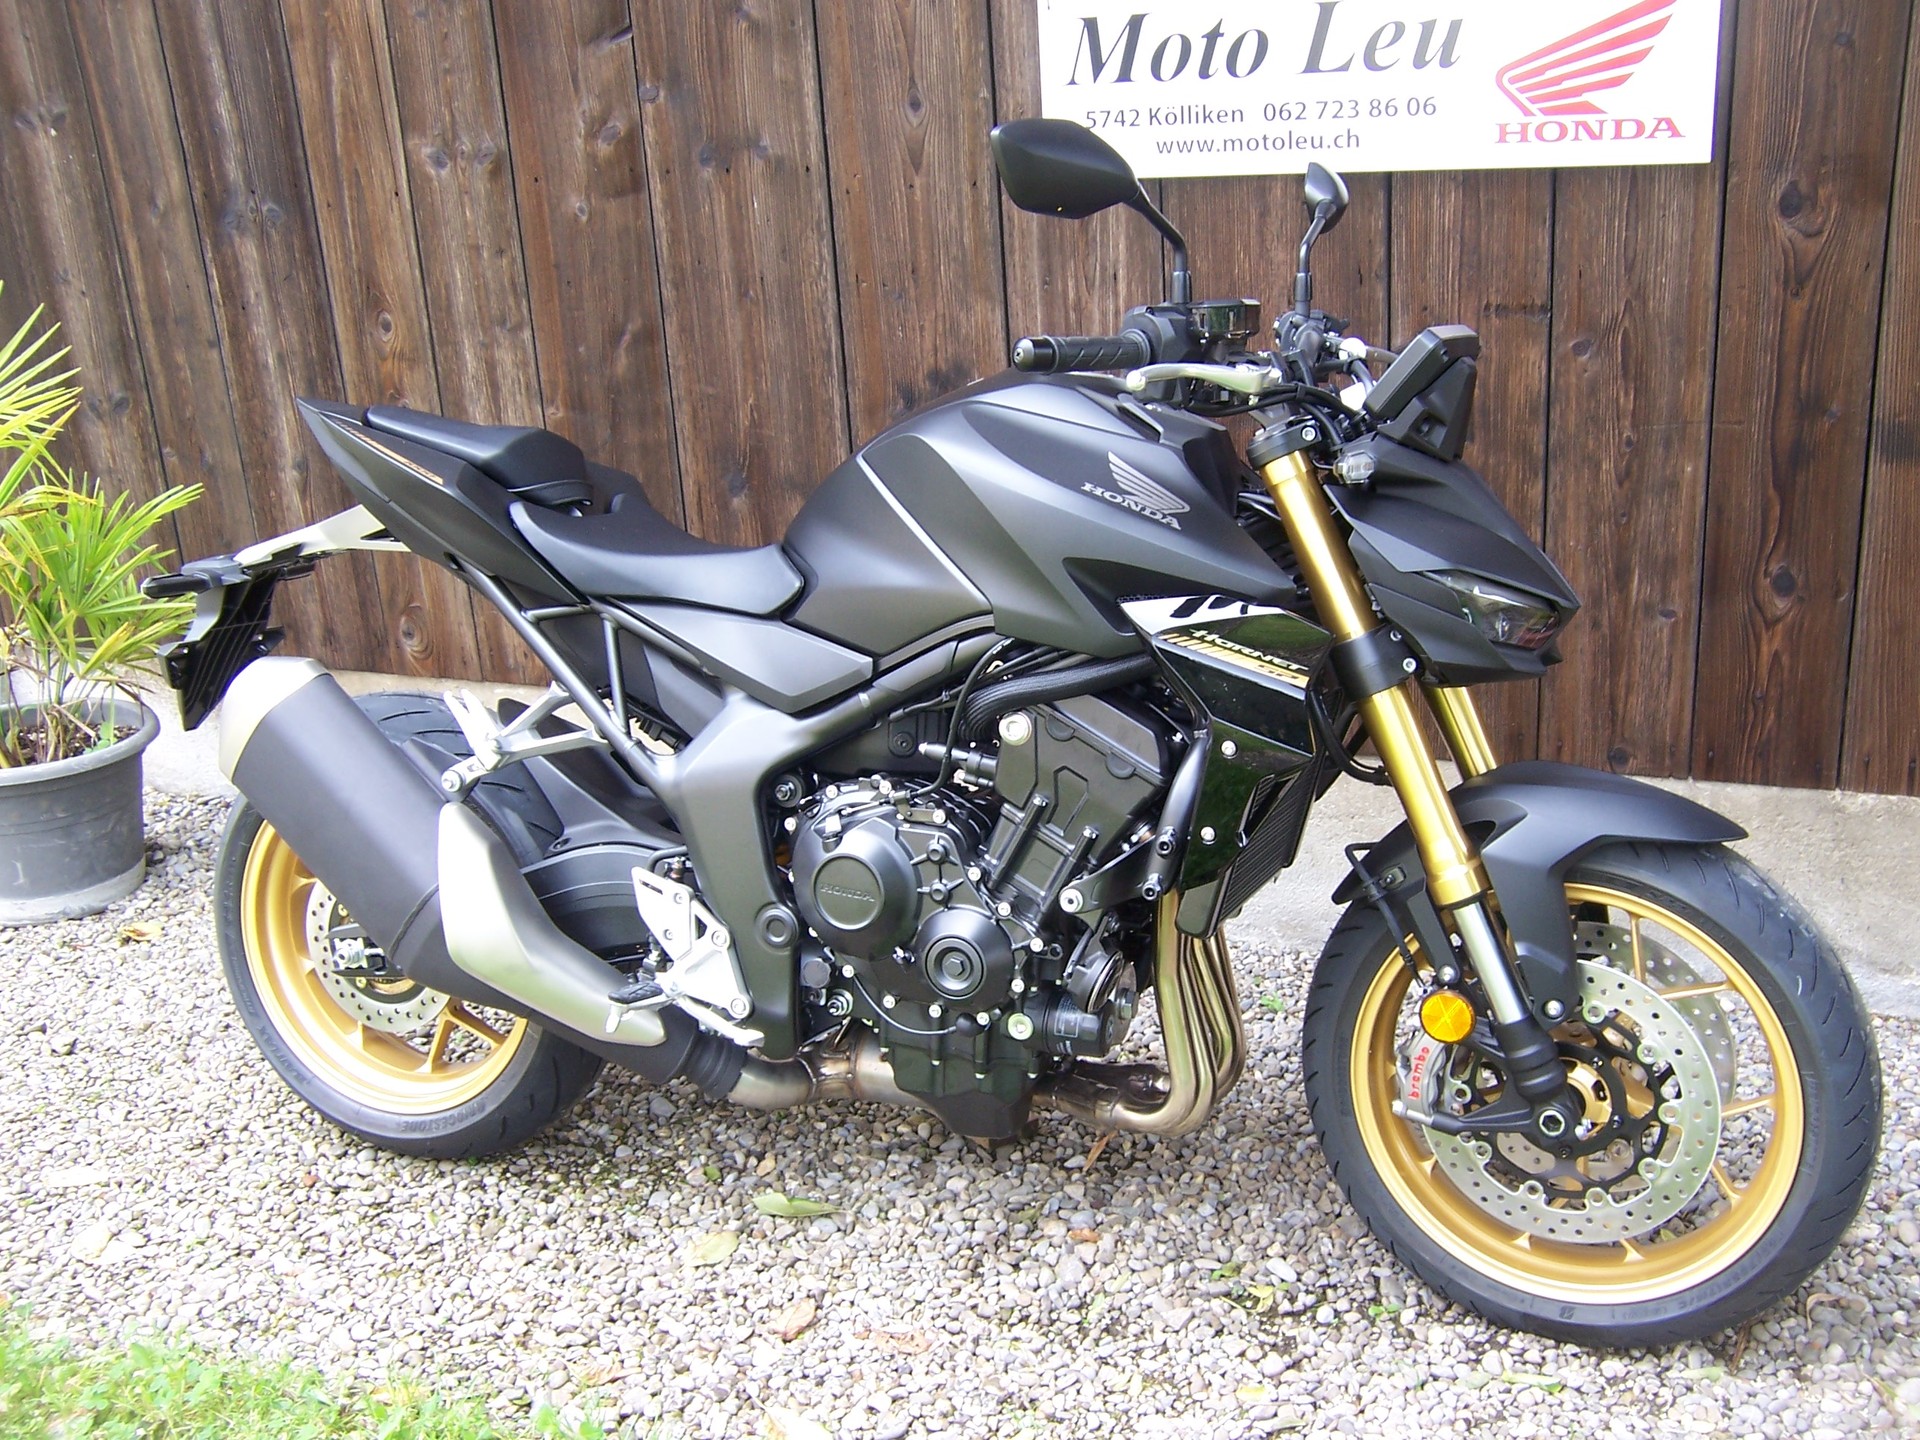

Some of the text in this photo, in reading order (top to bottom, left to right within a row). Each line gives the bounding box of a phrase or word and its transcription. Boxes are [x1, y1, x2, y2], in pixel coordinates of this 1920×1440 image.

[1064, 1, 1463, 86] Moto Leu
[1085, 96, 1437, 130] 5742 Kölliken 062 723 86 06
[1156, 128, 1360, 155] www.motoleu.ch
[1496, 117, 1686, 144] HONDA
[1081, 481, 1182, 530] HONDA
[820, 884, 875, 902] HONDA
[1408, 1046, 1430, 1099] brembo
